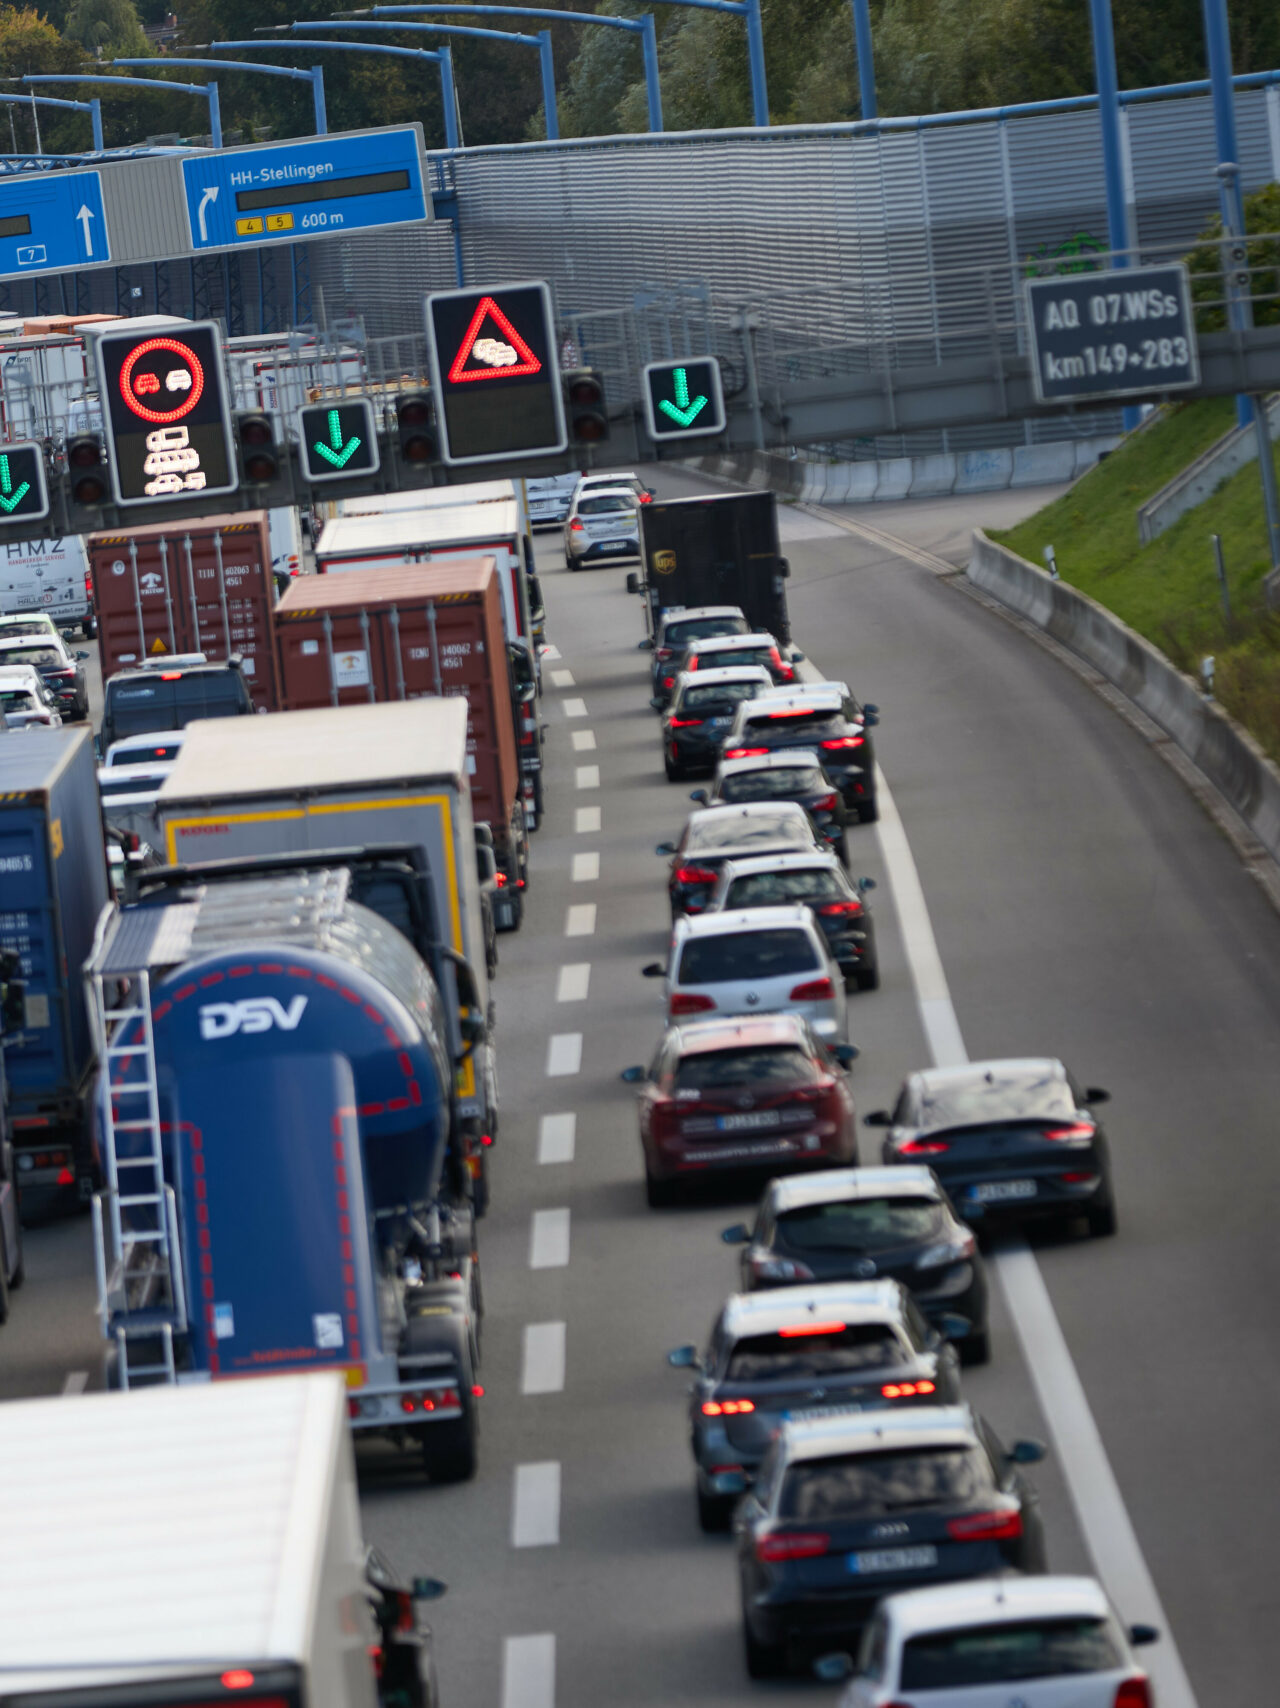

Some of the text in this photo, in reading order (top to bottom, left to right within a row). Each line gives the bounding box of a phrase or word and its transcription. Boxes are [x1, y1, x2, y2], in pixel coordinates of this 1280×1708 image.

[230, 162, 334, 186] HH-Stellingen
[301, 212, 327, 228] 600
[330, 213, 344, 225] m
[1045, 299, 1081, 331] AQ
[6, 537, 65, 559] HMZ
[225, 565, 250, 576] 602063
[200, 995, 308, 1040] DSV
